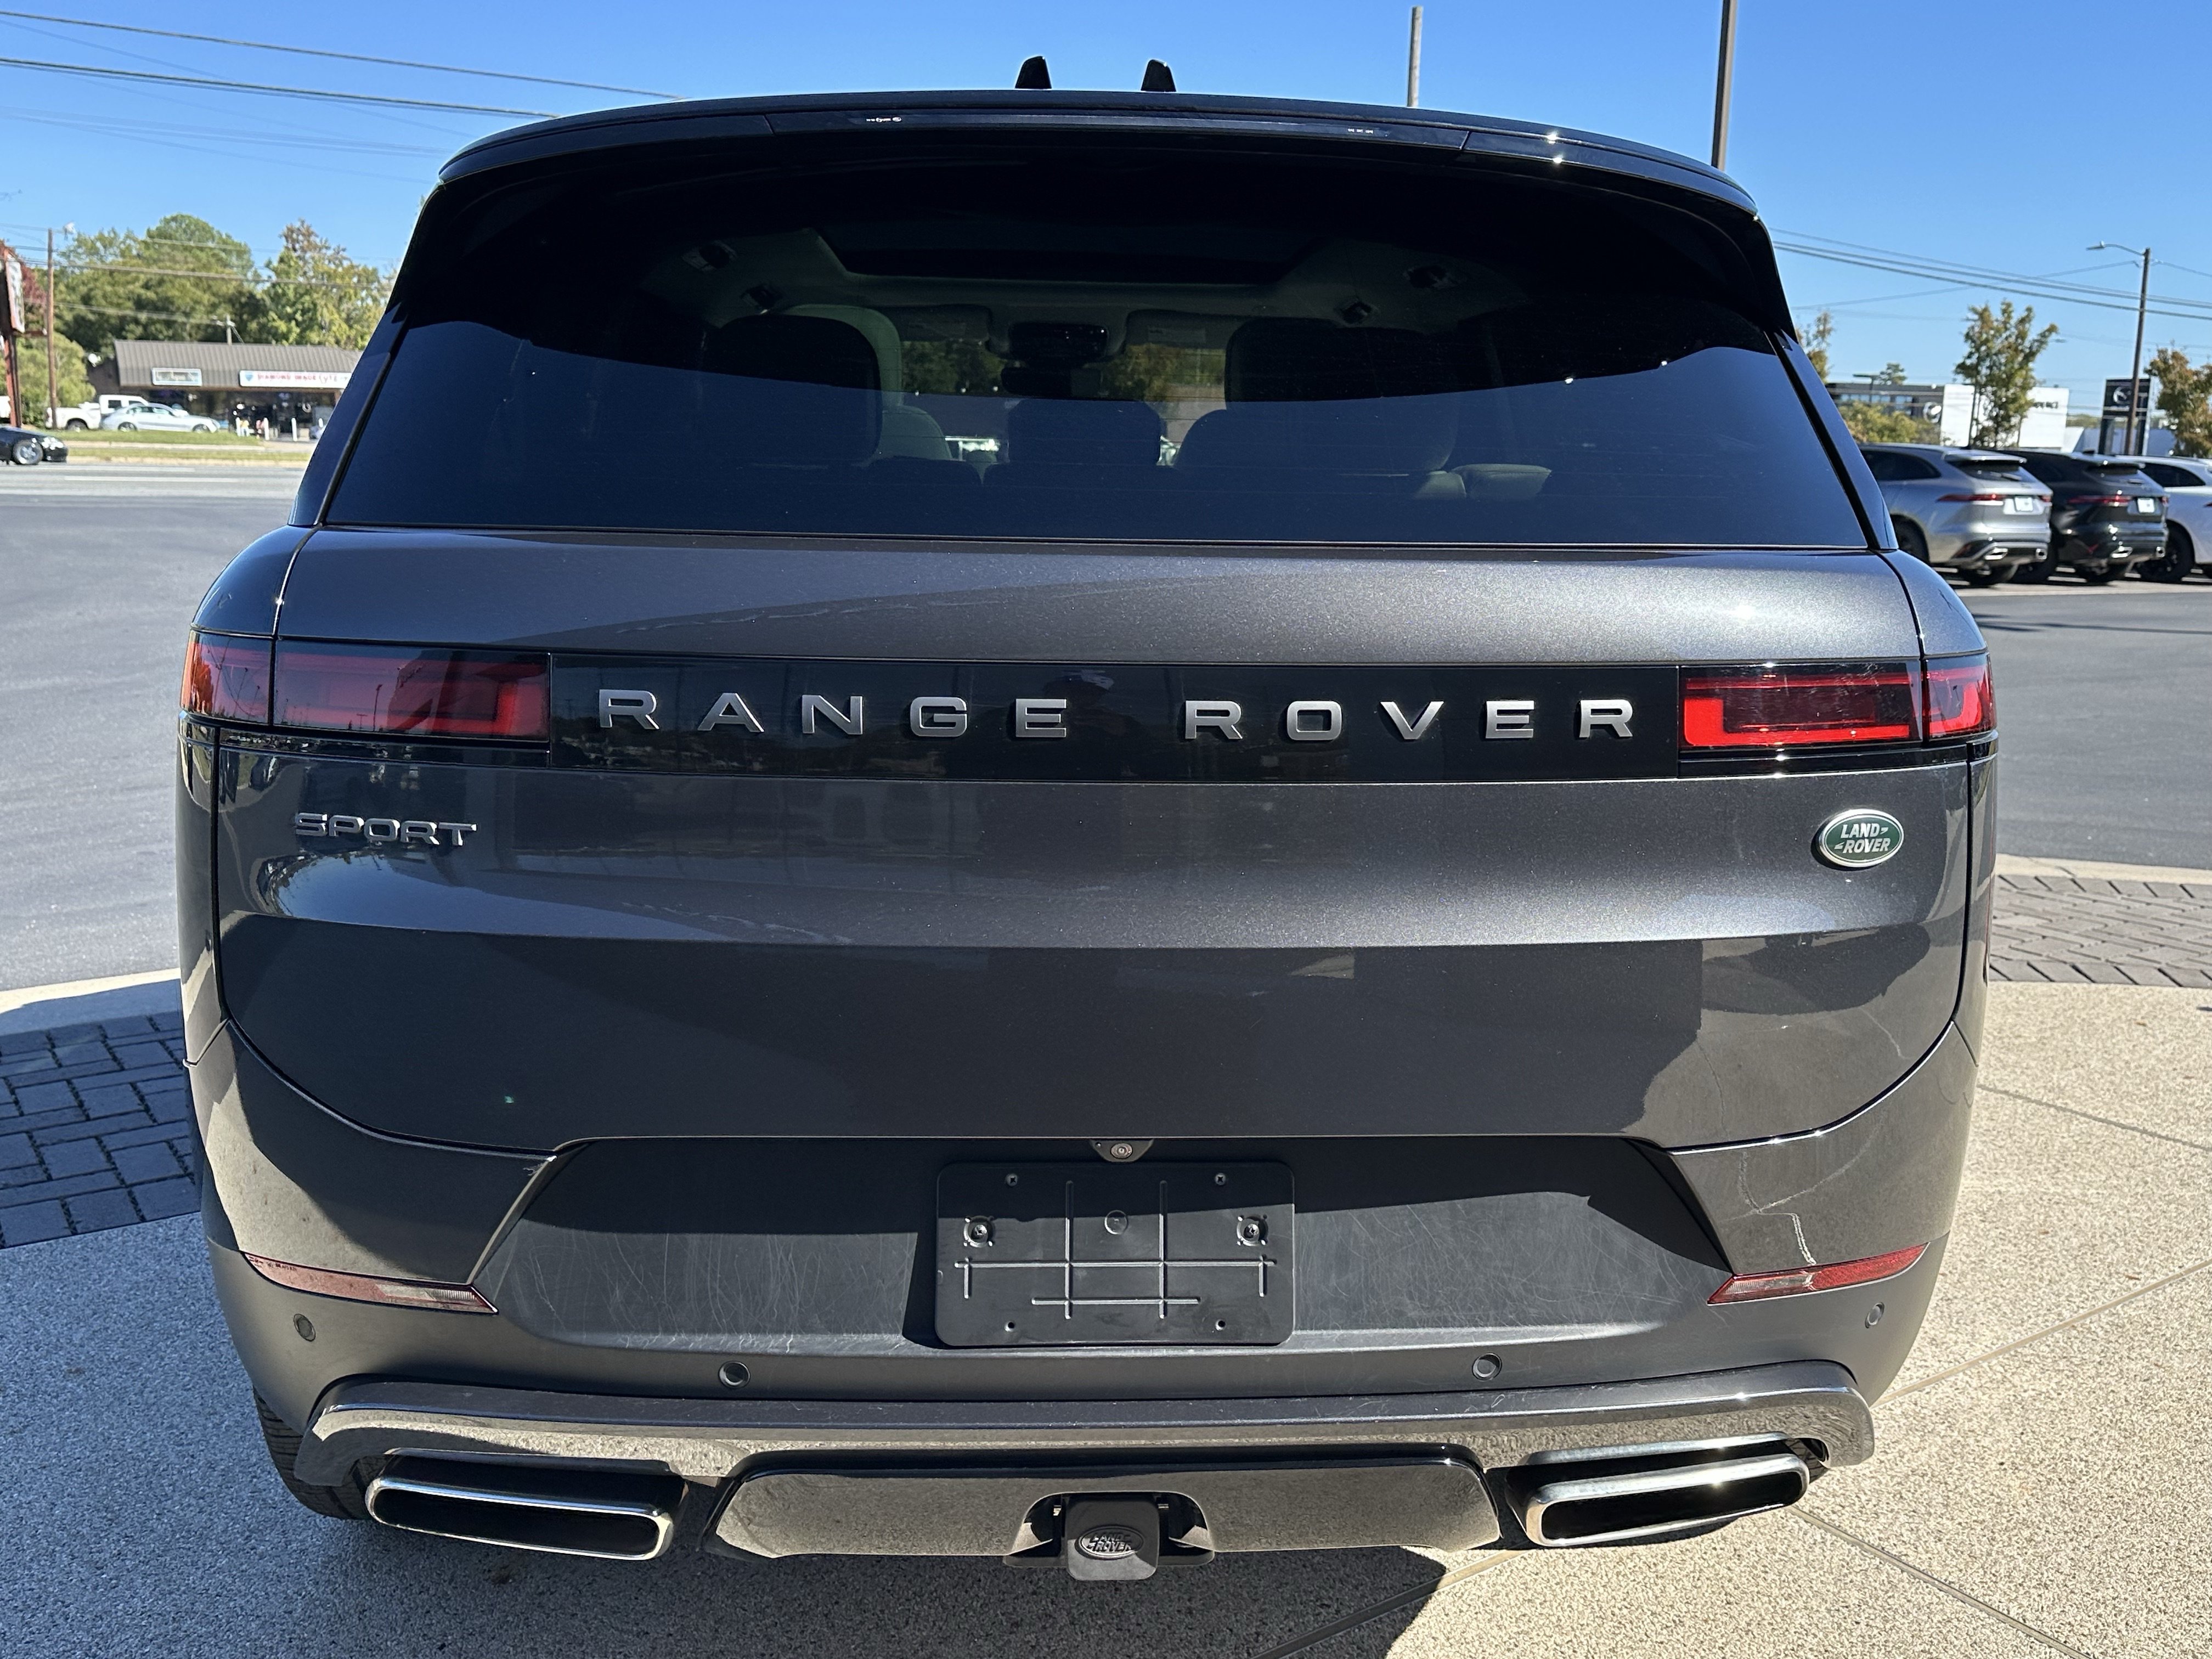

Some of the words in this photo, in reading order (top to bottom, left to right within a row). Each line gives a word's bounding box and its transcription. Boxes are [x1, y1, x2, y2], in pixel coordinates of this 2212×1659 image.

[598, 689, 1067, 737] RANGE
[1184, 699, 1634, 741] ROVER
[295, 812, 477, 846] SPORT
[1841, 823, 1880, 838] LAND
[1842, 838, 1891, 853] ROVER
